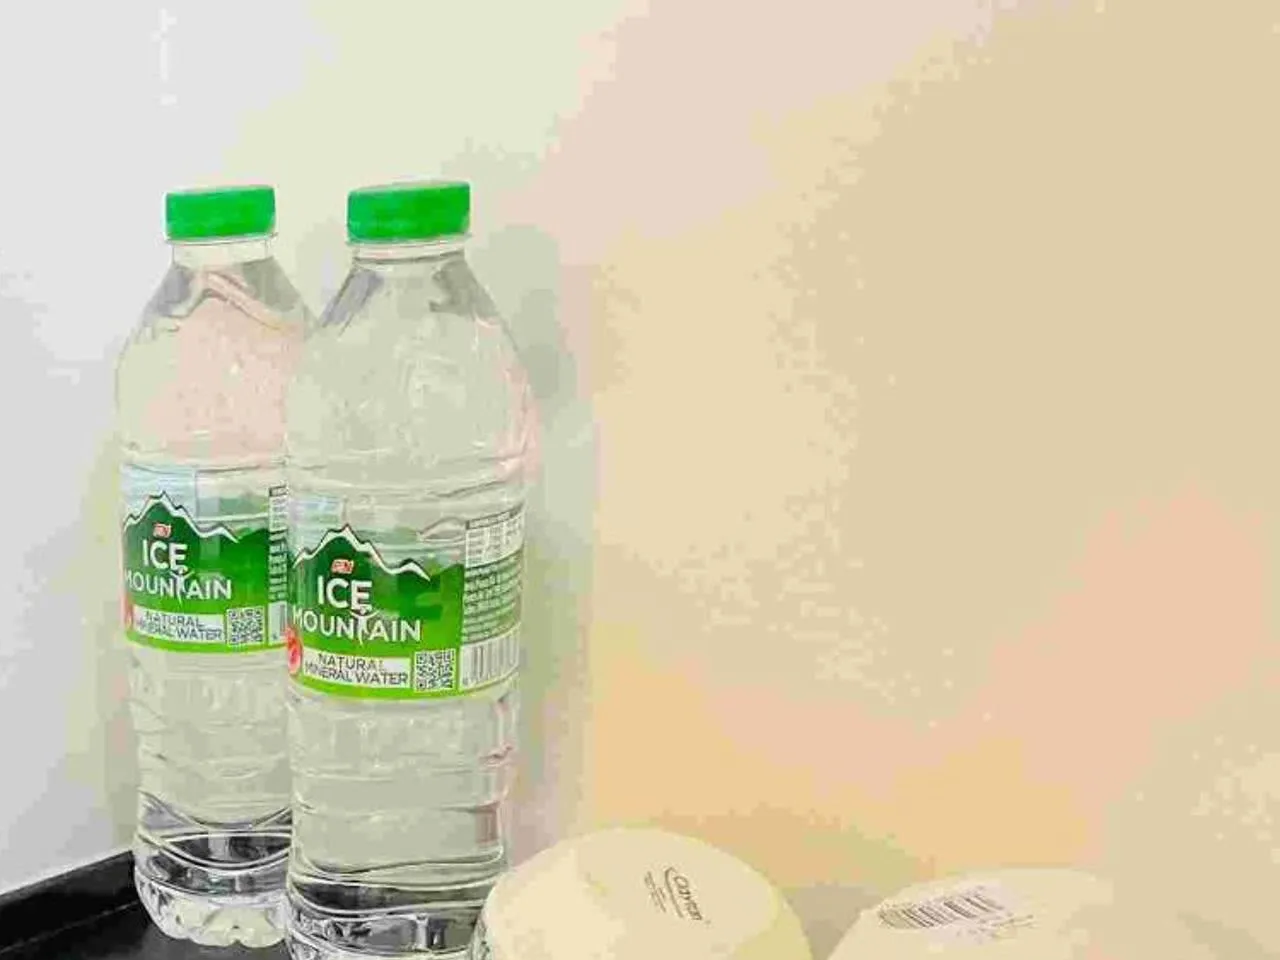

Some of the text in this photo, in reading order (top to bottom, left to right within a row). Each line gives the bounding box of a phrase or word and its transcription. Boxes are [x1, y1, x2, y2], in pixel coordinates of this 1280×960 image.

[142, 539, 188, 571] ICE
[318, 575, 373, 611] ICE
[356, 671, 409, 685] WATER
